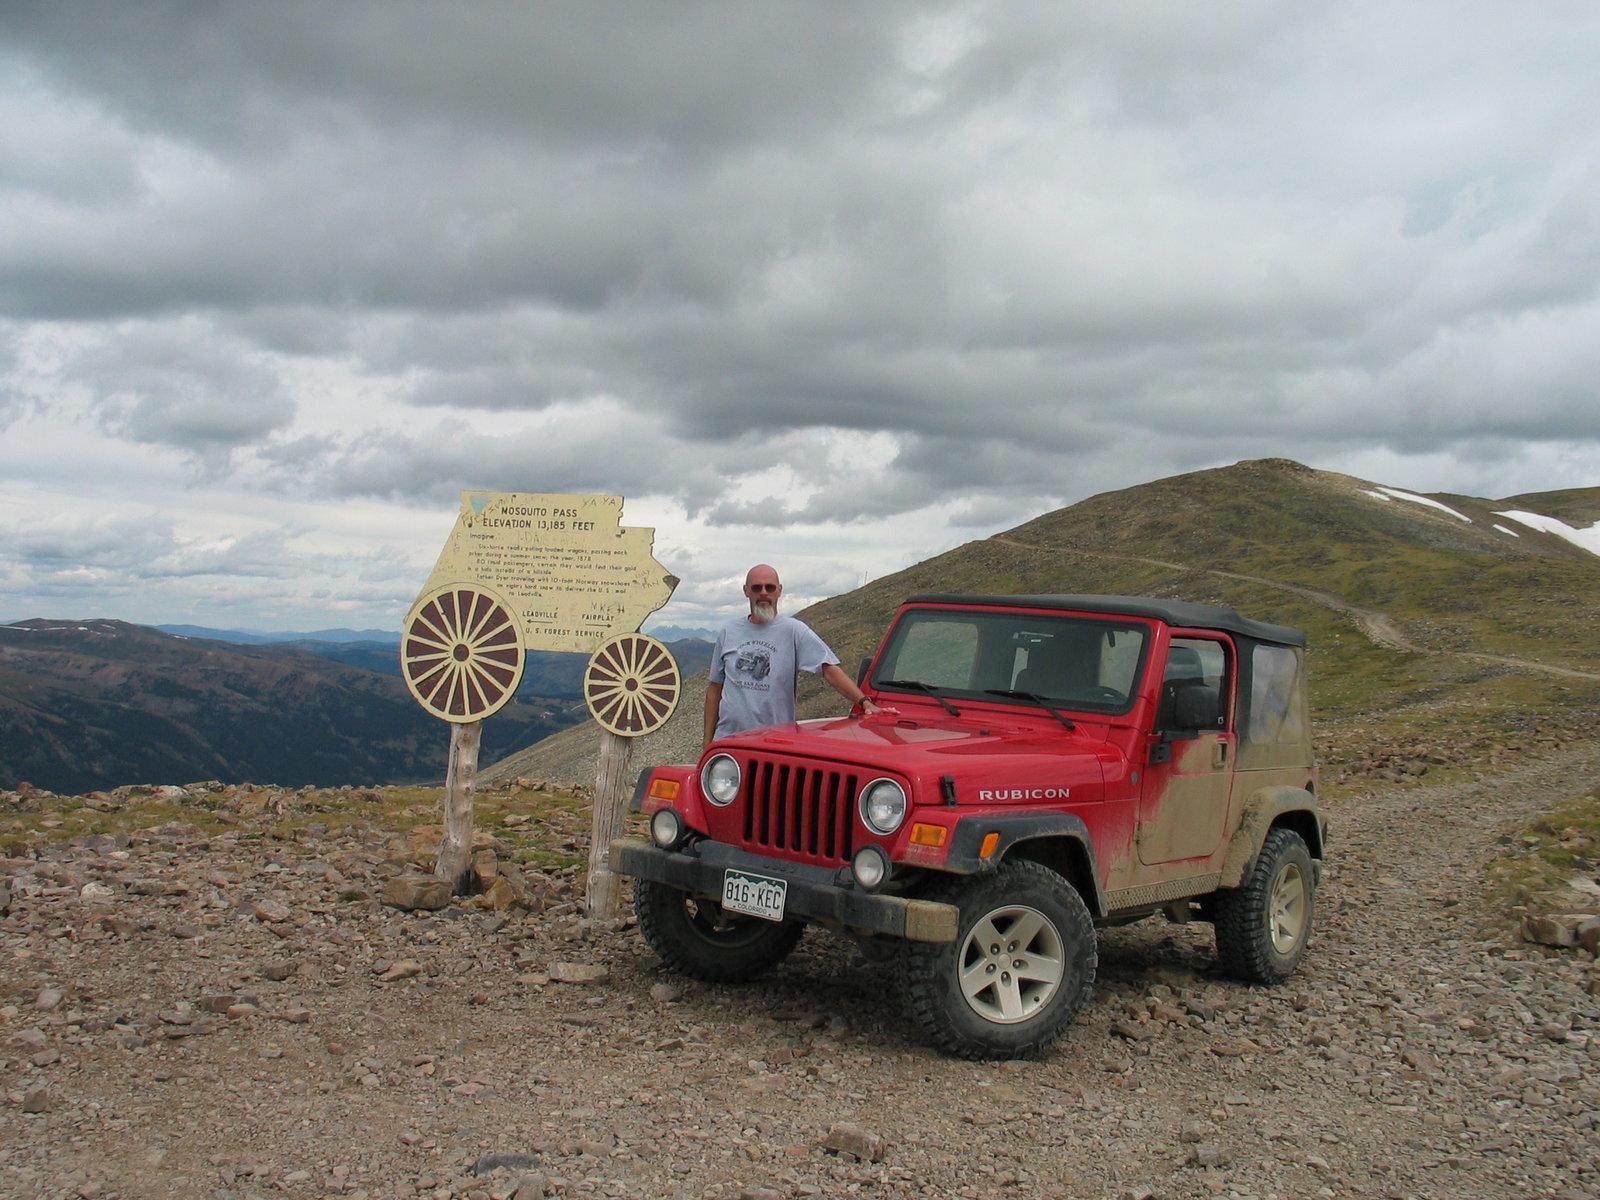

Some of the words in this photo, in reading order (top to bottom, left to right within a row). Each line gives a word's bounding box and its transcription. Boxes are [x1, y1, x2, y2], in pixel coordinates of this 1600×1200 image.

[501, 506, 547, 516] MOSQUITO
[553, 508, 577, 518] PASS
[482, 518, 532, 529] ELEVATION
[537, 520, 565, 531] 13,185
[572, 521, 595, 531] FEET
[522, 610, 558, 619] LEADVILLE
[581, 613, 614, 621] FAIRPLAY
[544, 628, 571, 636] FOREST
[575, 630, 605, 638] SERVICE
[979, 788, 1071, 800] RUBICON
[737, 903, 768, 915] COLORADO
